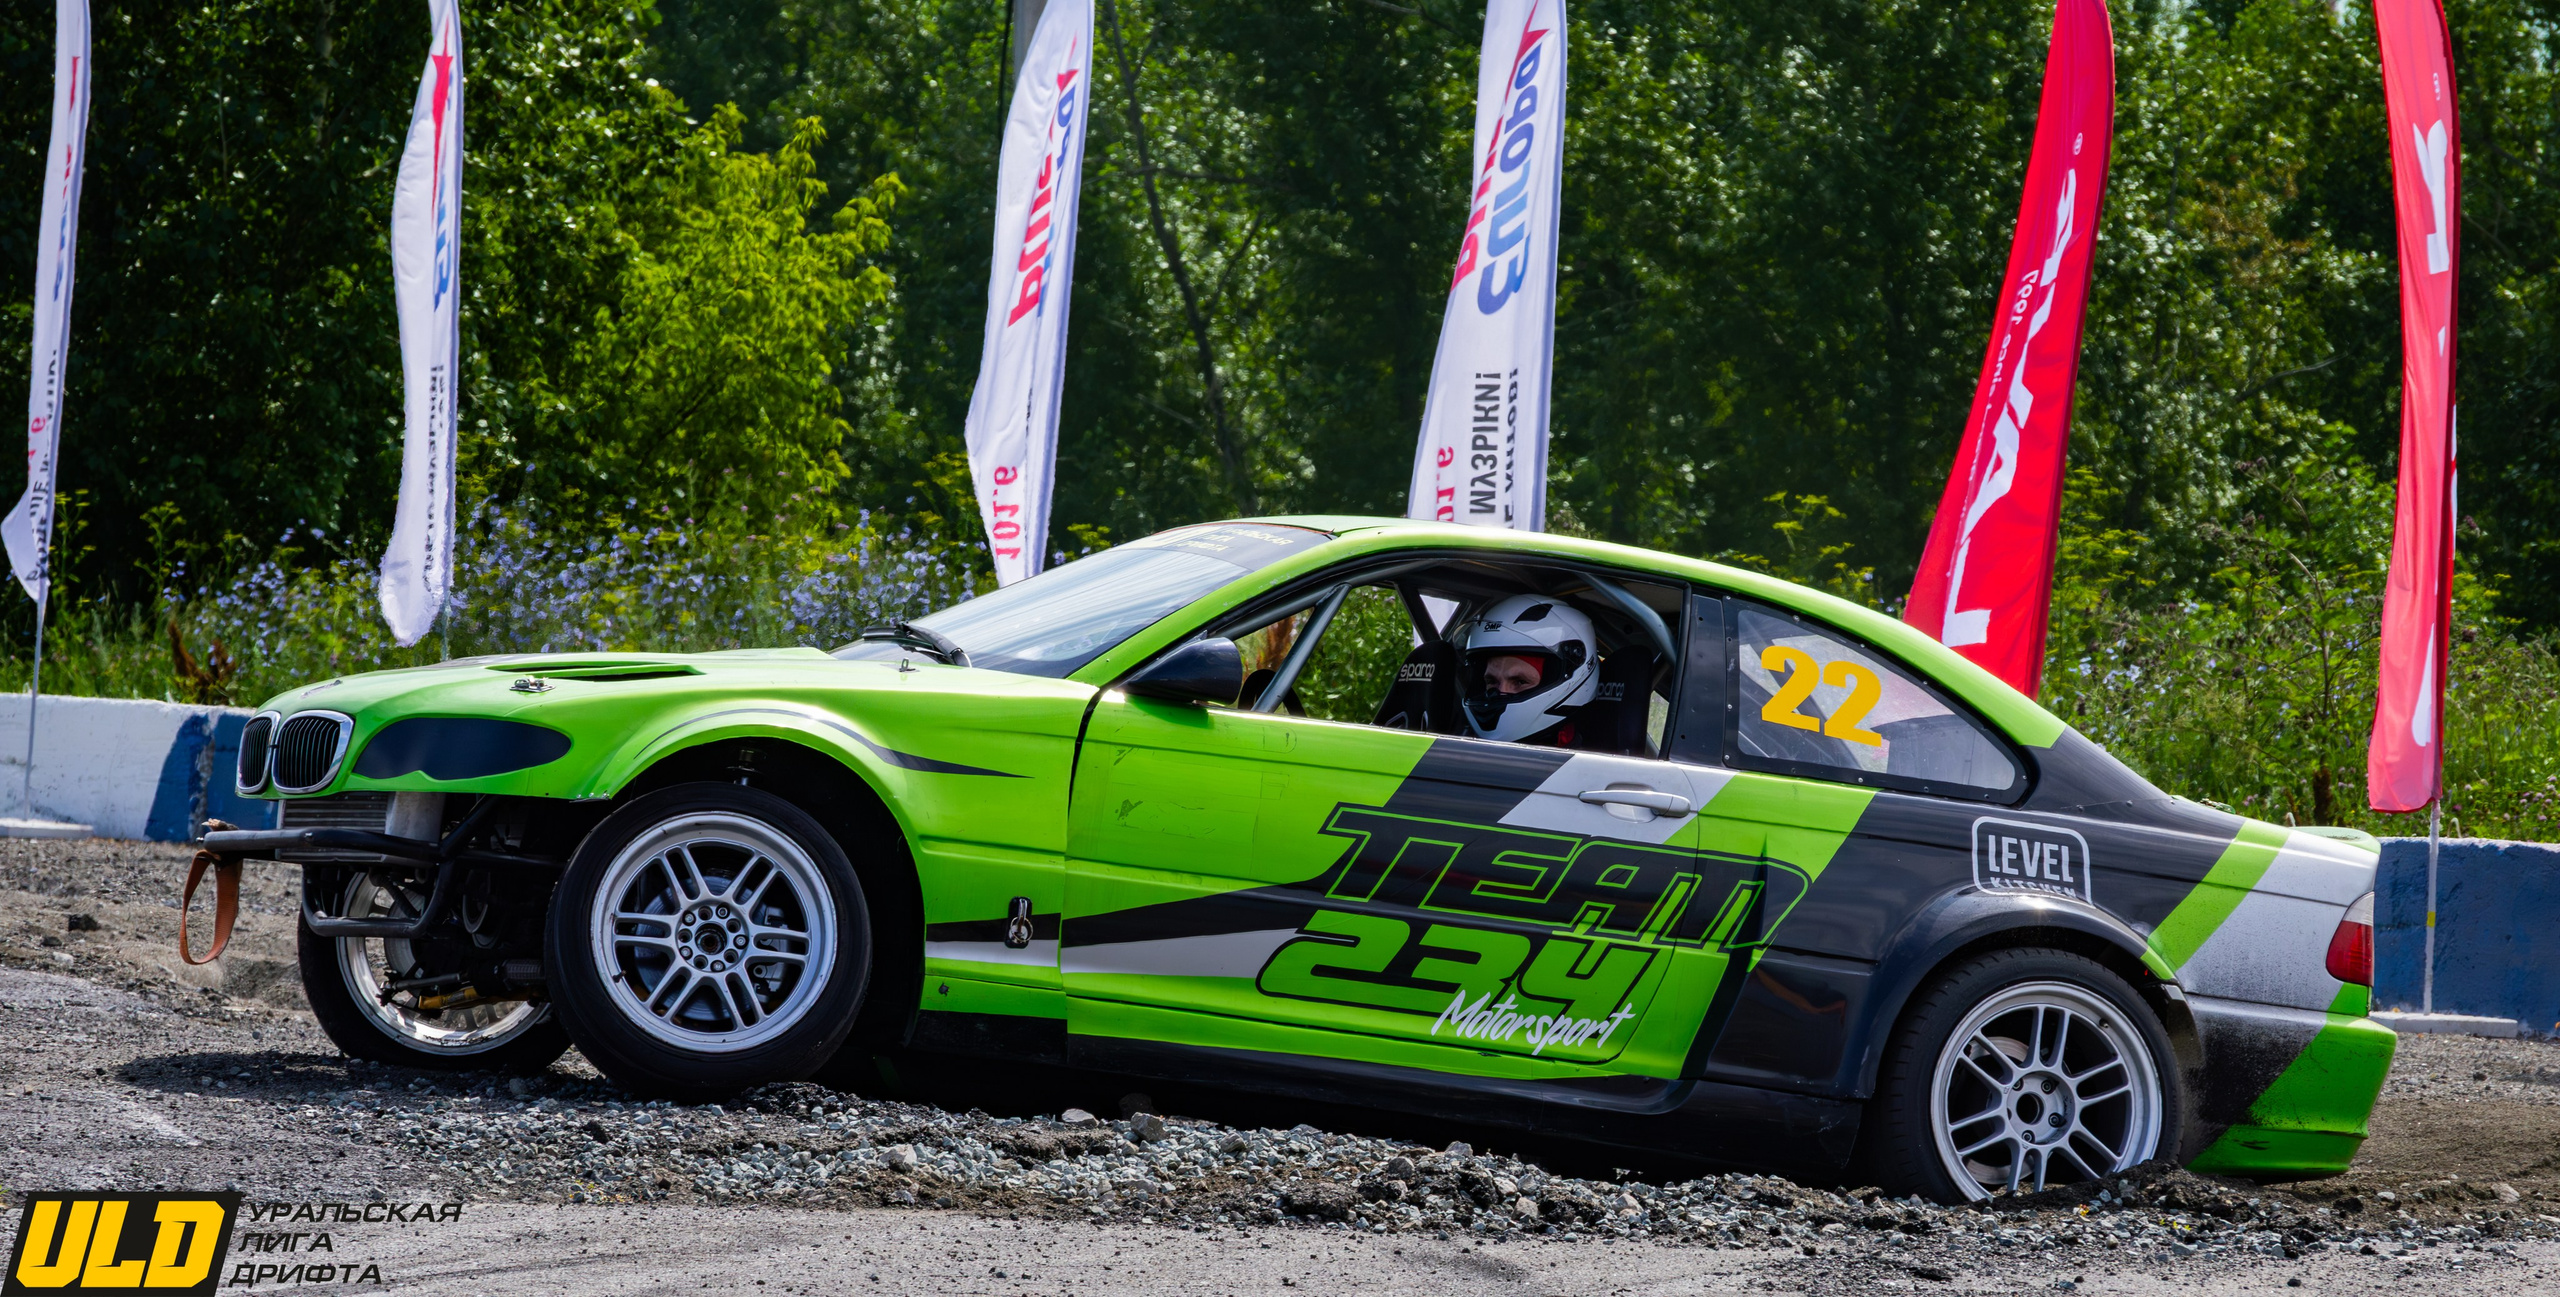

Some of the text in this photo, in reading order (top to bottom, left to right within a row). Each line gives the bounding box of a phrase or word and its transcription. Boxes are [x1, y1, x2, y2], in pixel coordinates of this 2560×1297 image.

[1398, 662, 1435, 682] sparco
[1597, 682, 1625, 702] parco
[1761, 645, 1882, 747] 22
[1319, 803, 1813, 951] TEAM
[1988, 835, 2074, 883] LEVEL
[1256, 909, 1660, 1038] 234
[1431, 989, 1636, 1056] Motorsport
